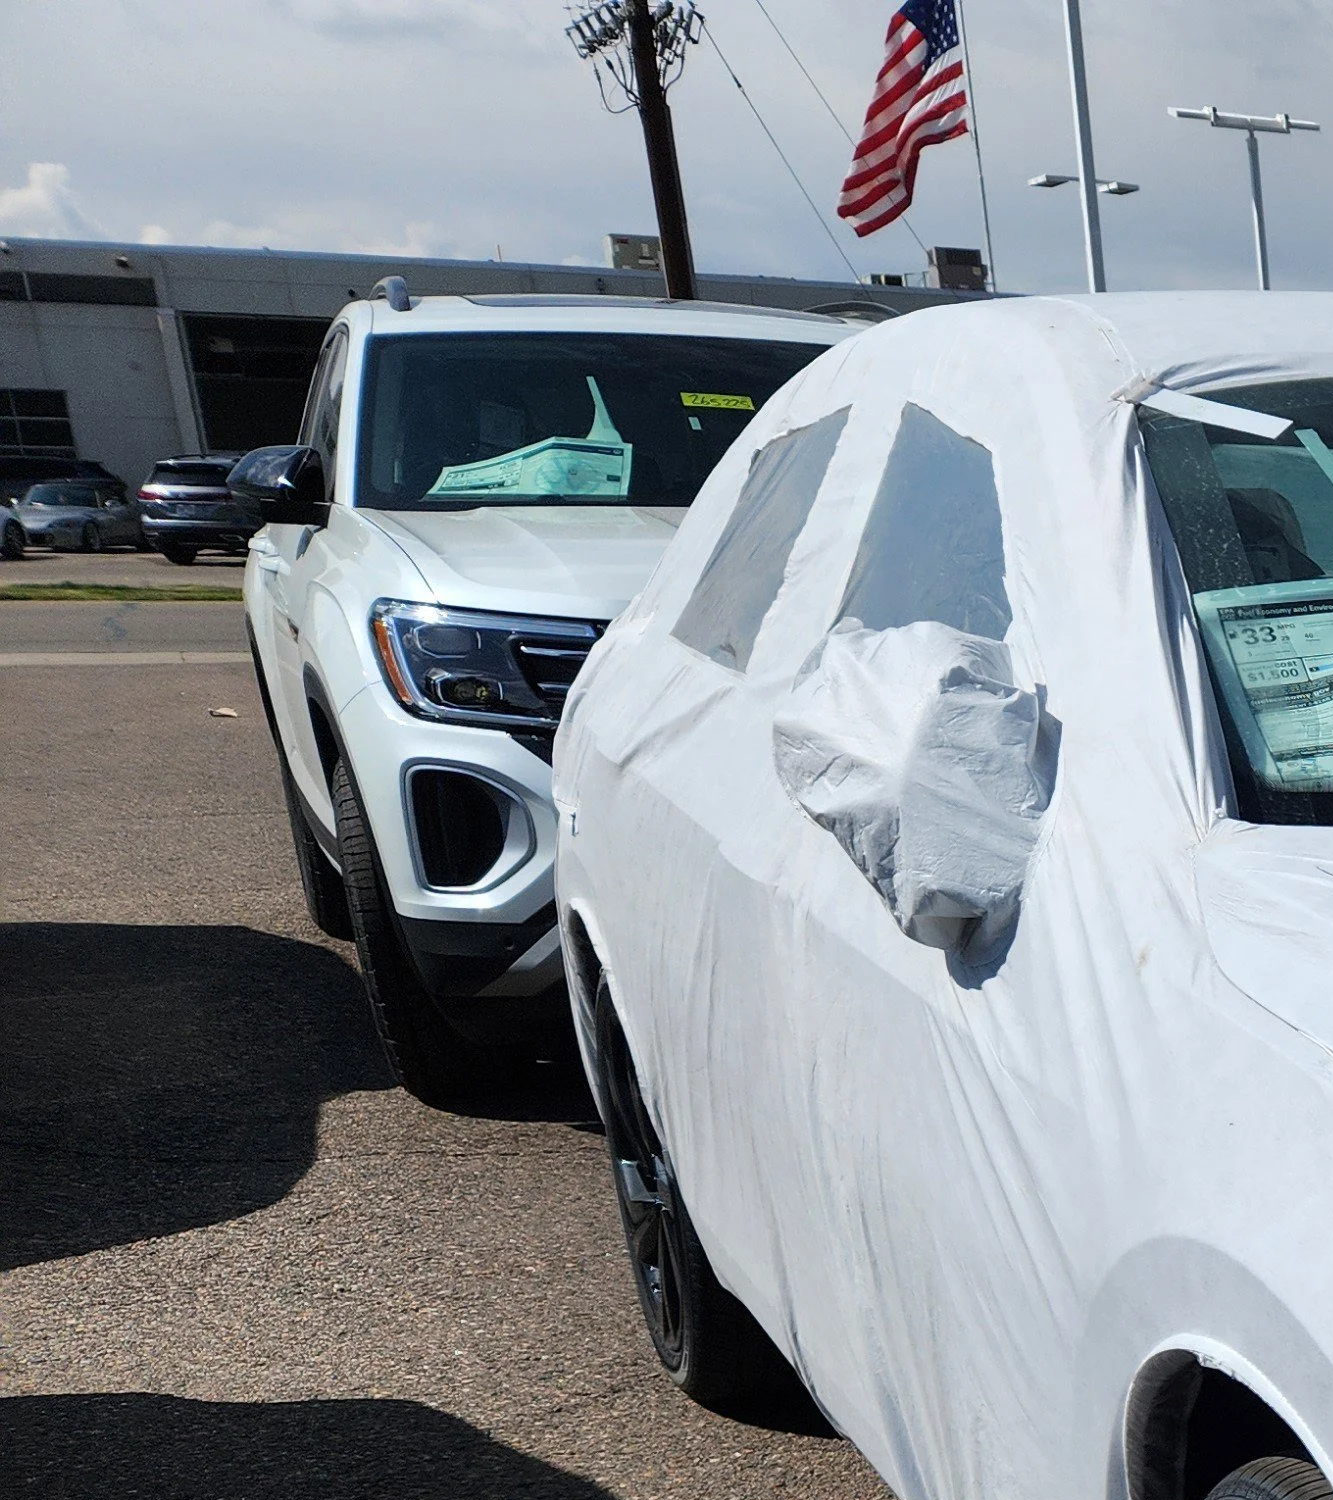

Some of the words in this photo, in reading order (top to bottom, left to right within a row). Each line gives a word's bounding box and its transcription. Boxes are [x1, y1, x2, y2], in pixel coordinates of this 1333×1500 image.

[1256, 607, 1292, 616] Economy
[1293, 605, 1307, 613] and
[1241, 626, 1277, 644] 33
[1275, 660, 1297, 668] cost
[1248, 668, 1299, 682] $1,500
